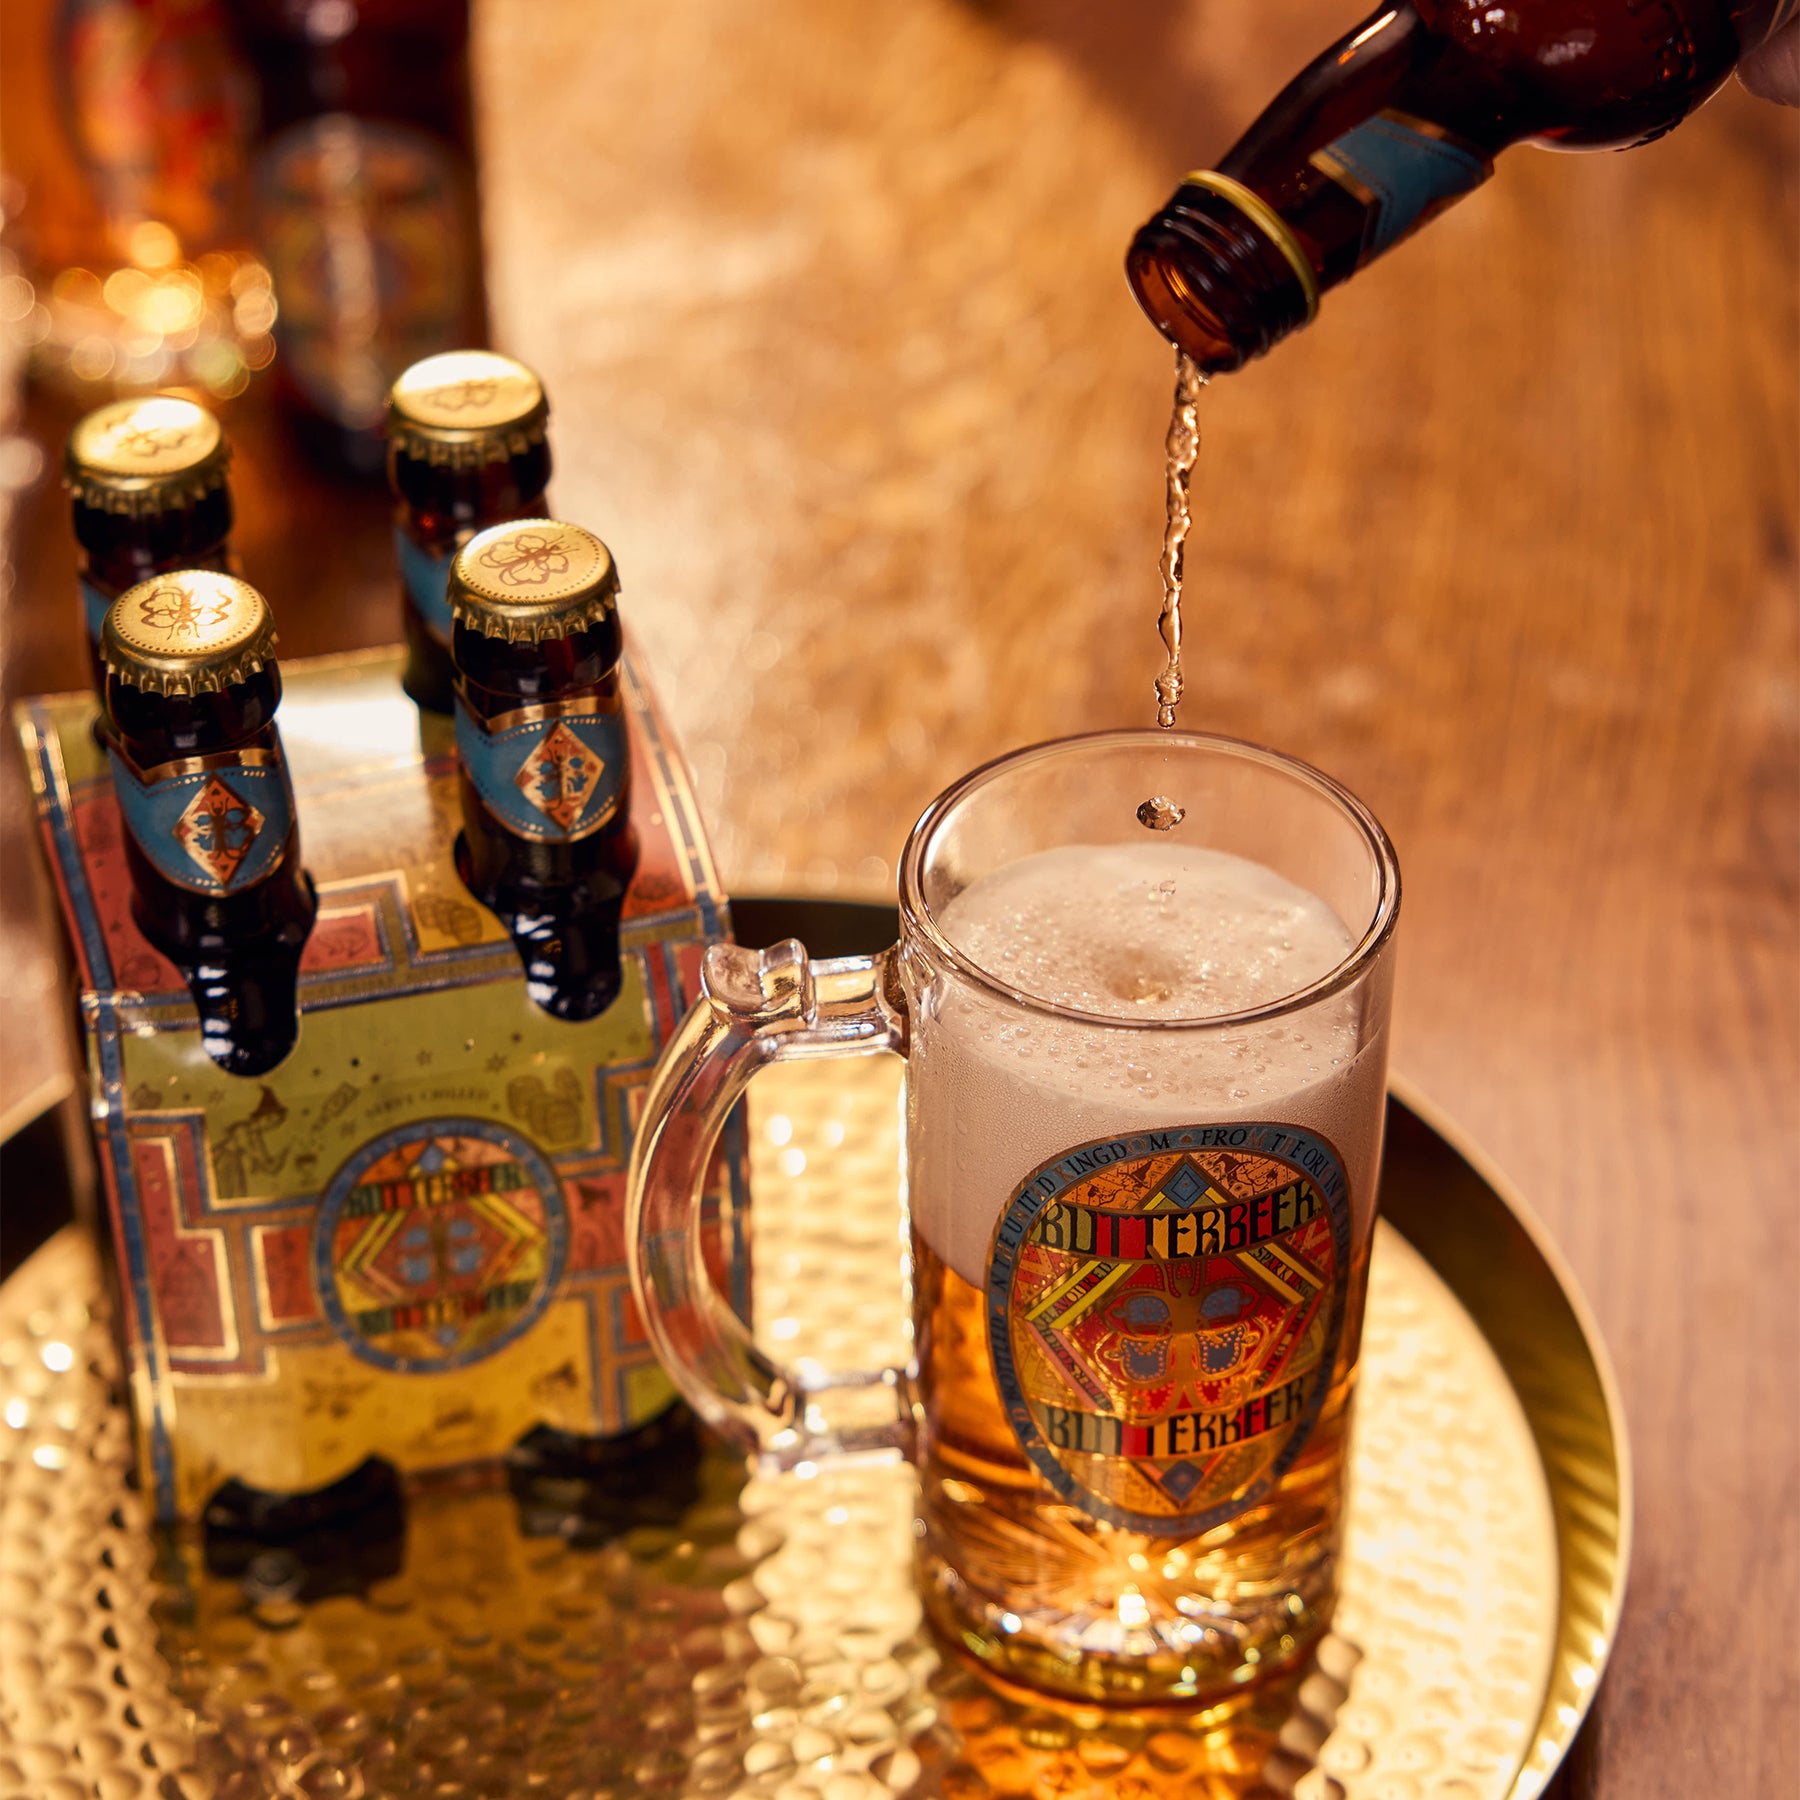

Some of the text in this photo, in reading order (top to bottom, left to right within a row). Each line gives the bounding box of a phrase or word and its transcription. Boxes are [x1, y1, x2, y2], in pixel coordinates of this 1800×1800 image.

[1004, 1174, 1057, 1234] UNITED
[1053, 1132, 1171, 1183] KINGDOM
[1200, 1128, 1267, 1148] FROM
[1270, 1132, 1305, 1159] THE
[1039, 1178, 1314, 1260] BUTTERBEER
[1046, 1376, 1305, 1457] BUTTERBEER
